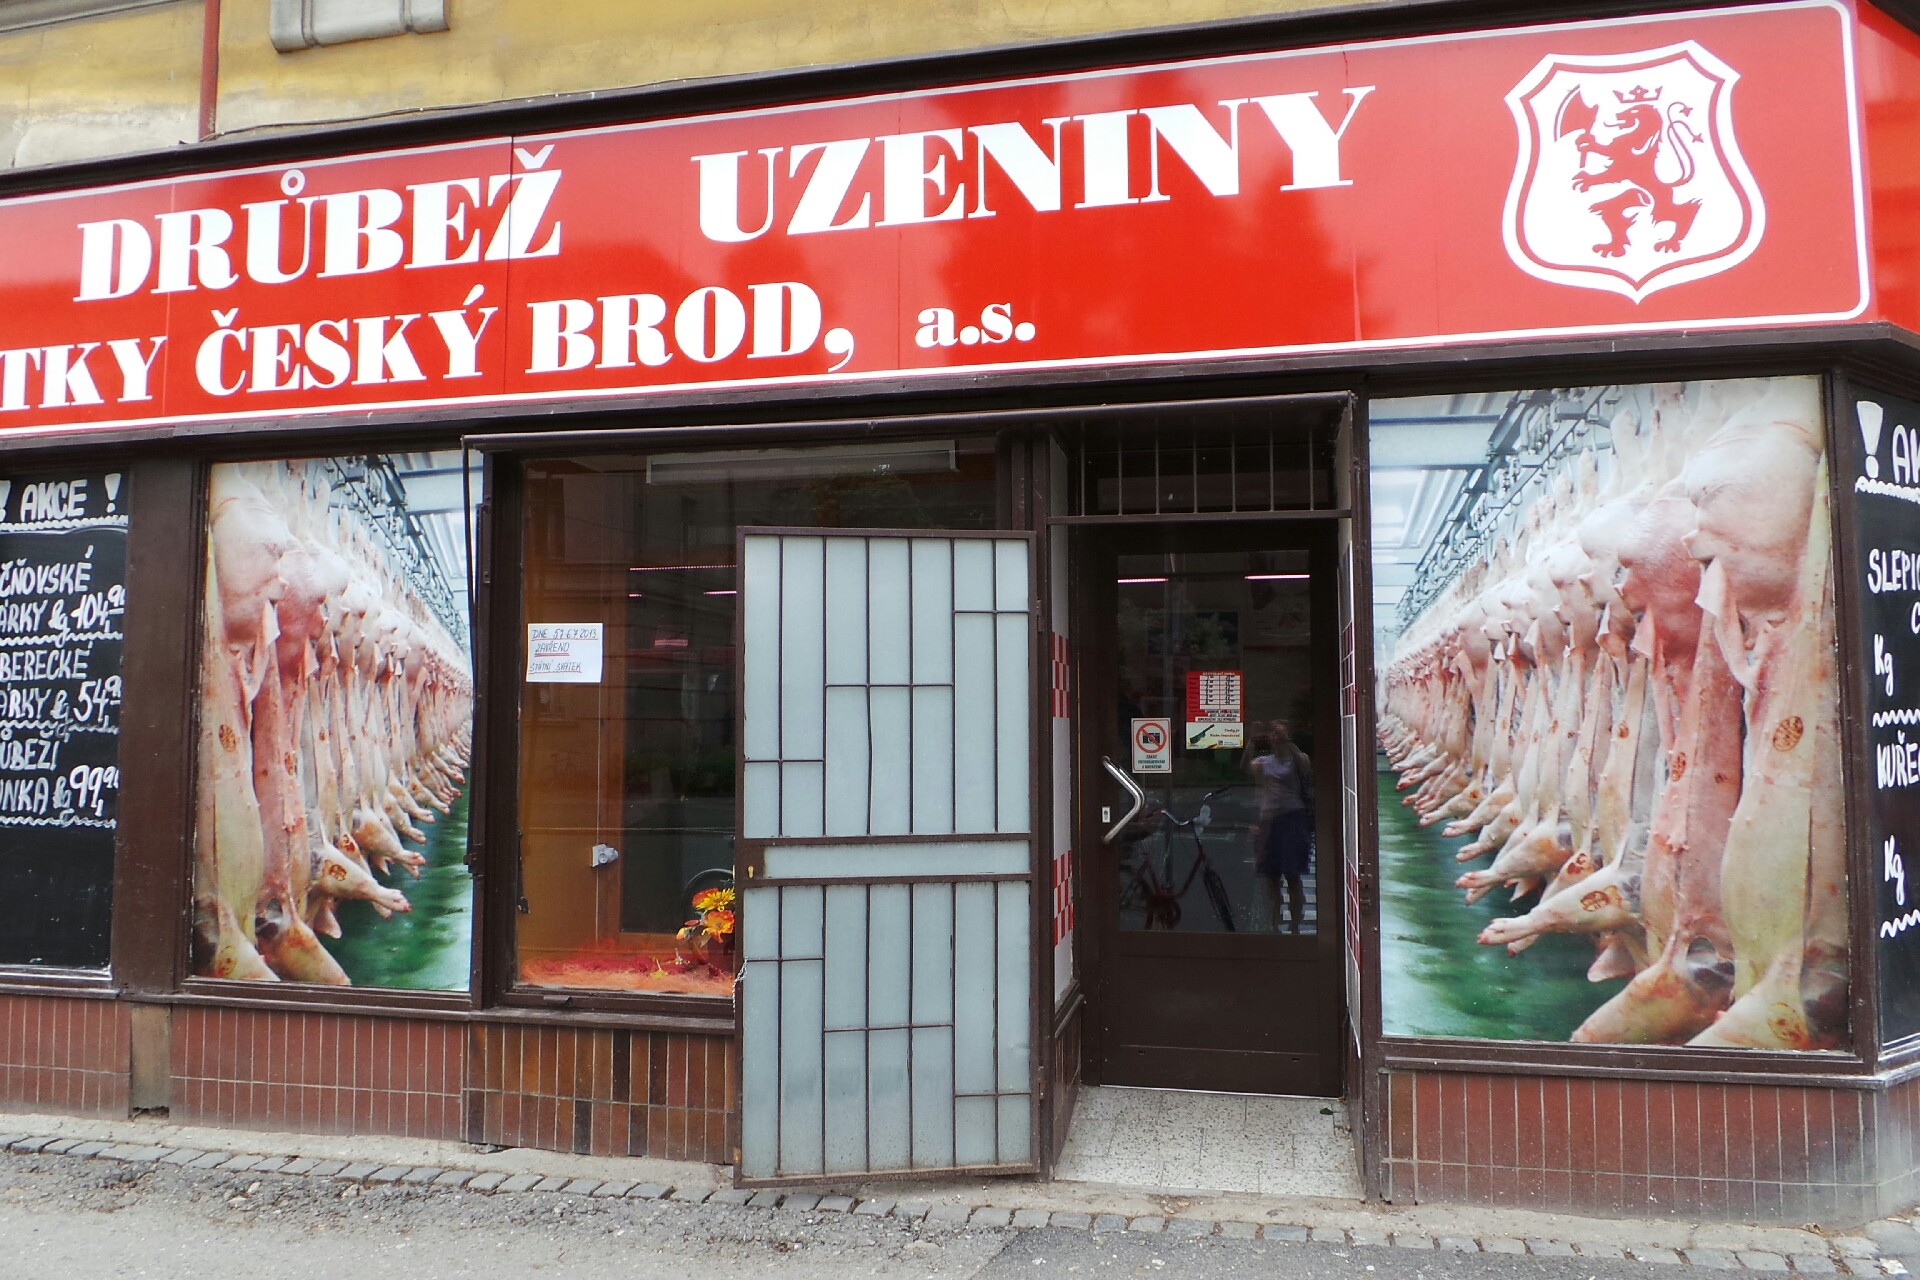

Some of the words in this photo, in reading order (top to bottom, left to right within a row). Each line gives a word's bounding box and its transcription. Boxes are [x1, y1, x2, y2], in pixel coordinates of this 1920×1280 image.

[73, 144, 562, 303] DRŮBEŽ
[691, 85, 1376, 243] UZENINY
[195, 284, 498, 396] ČESKÝ
[524, 281, 855, 373] BROD,
[915, 301, 1036, 348] a.s.
[20, 479, 88, 522] AKCE
[1877, 729, 1920, 790] KUŘE
